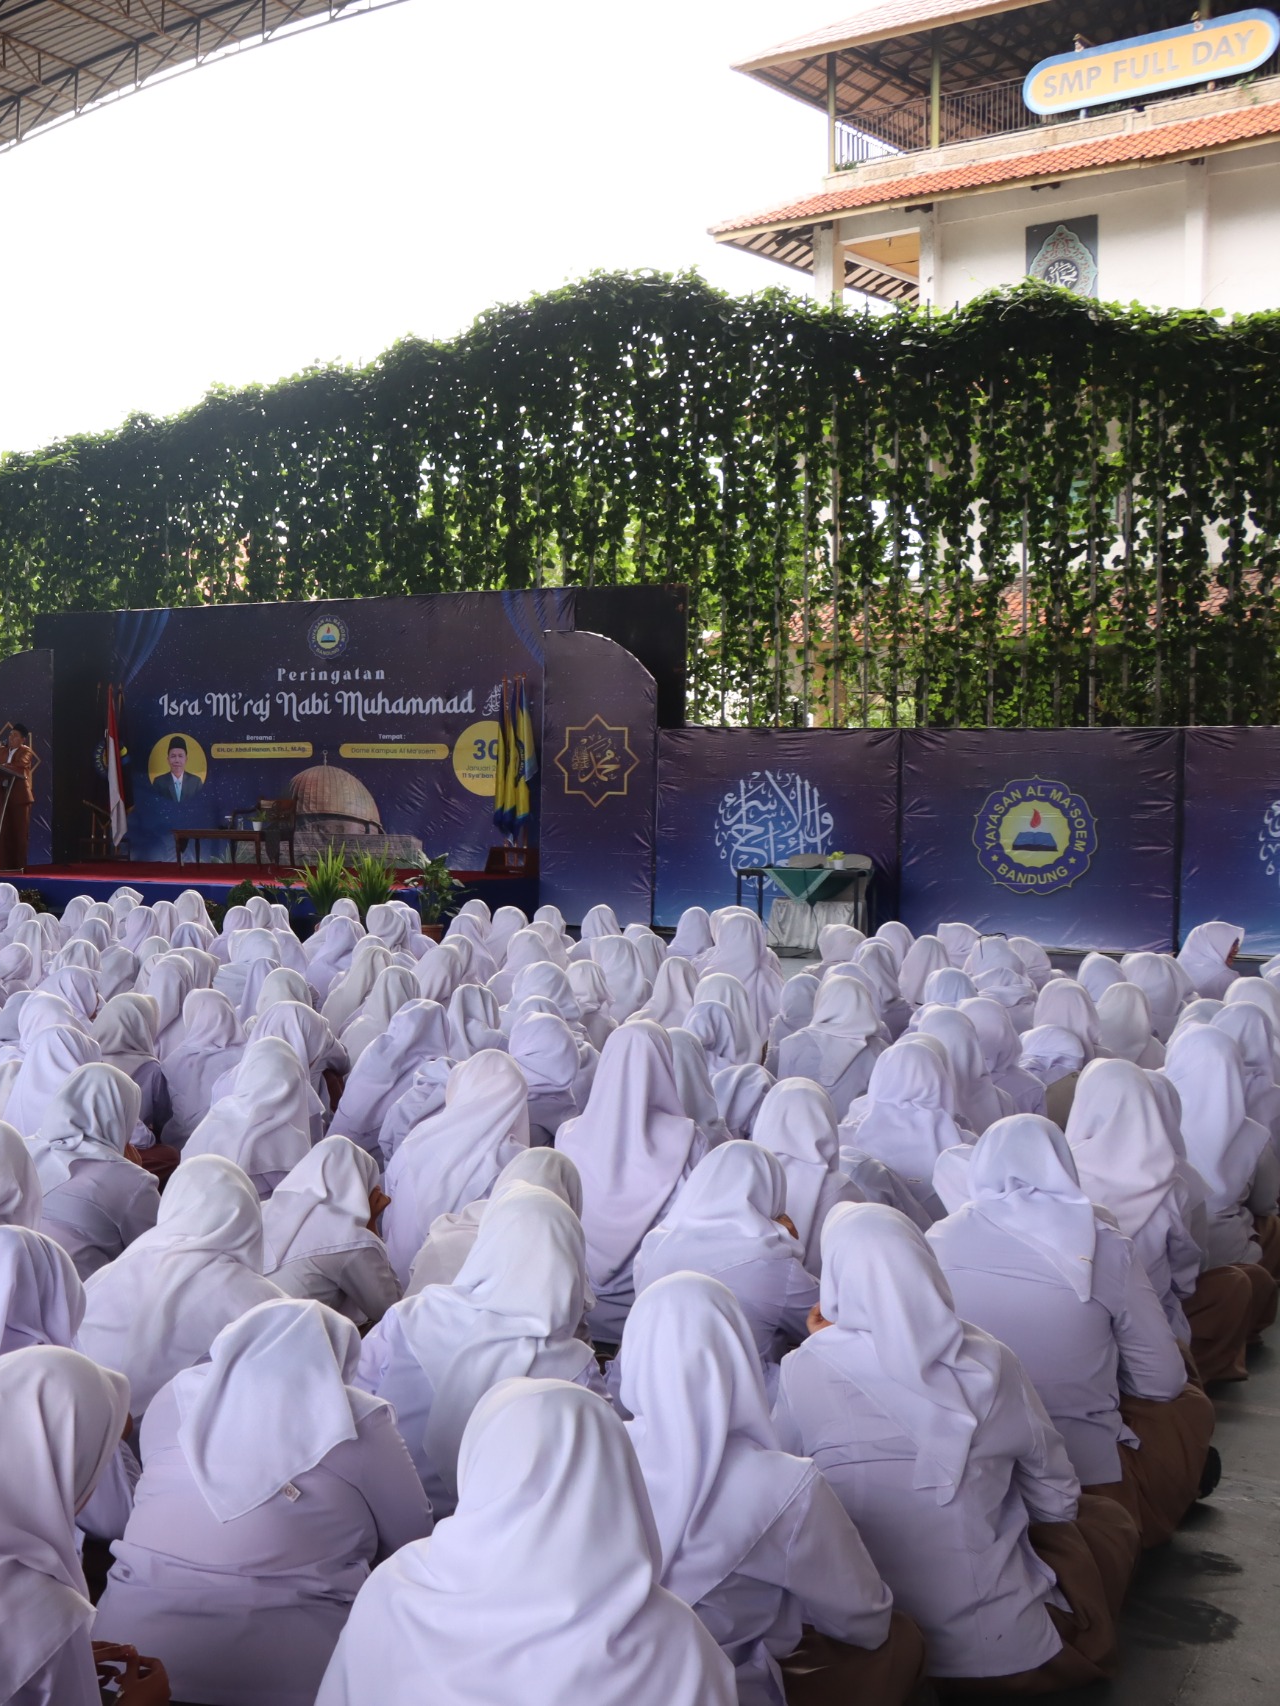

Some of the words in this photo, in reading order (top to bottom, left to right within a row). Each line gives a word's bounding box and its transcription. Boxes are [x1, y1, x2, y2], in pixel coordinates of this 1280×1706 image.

[1043, 66, 1102, 98] SMP
[1113, 48, 1180, 84] FULL
[1191, 29, 1255, 67] DAY
[277, 667, 385, 685] Peringatan
[158, 693, 202, 717] Isra
[276, 692, 332, 722] Nabi
[335, 689, 476, 722] Muhammad
[984, 789, 1022, 850] YAYASAN
[1026, 786, 1045, 797] AL
[997, 863, 1068, 885] BANDUNG
